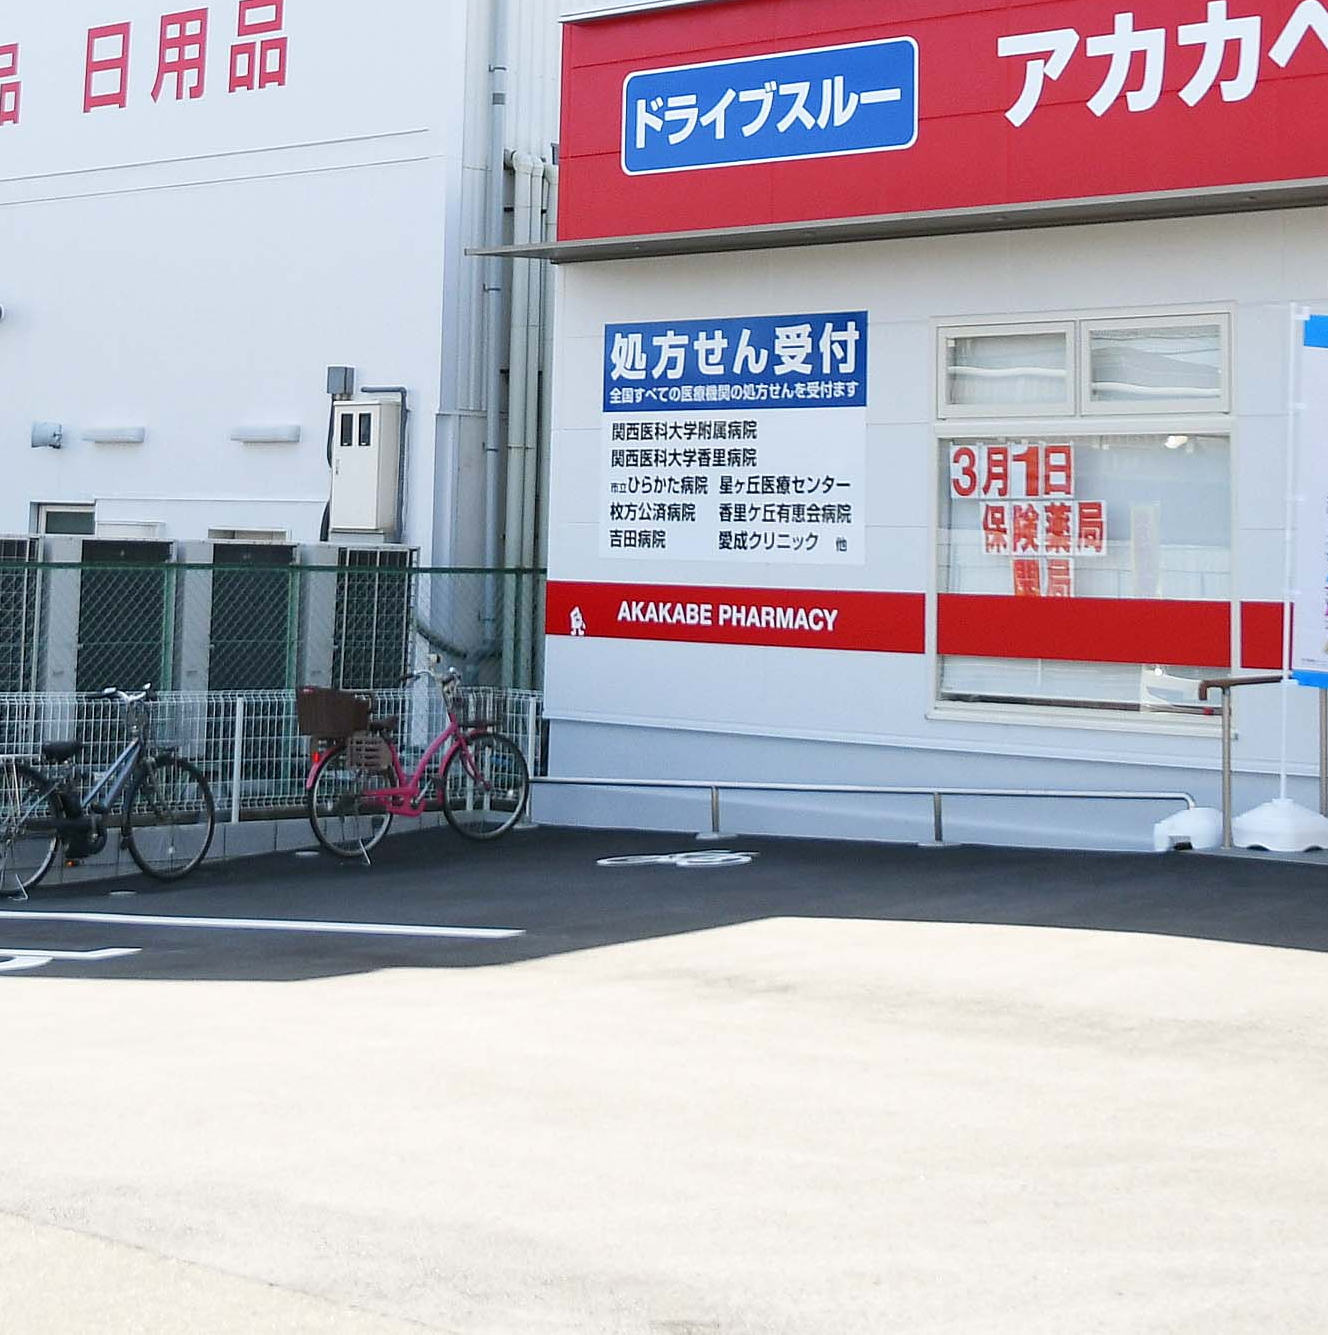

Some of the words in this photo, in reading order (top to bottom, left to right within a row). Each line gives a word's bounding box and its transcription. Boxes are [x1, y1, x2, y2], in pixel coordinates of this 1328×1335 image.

[635, 74, 902, 149] ドライブスルー
[609, 321, 861, 381] 処方せん受付
[609, 381, 860, 405] 全国すべての医療機関の処方せんを受付ます
[611, 420, 758, 441] 関西医科大学附属病院
[611, 447, 758, 468] 関西医科大学香里病院
[952, 445, 1072, 497] 3月1日
[609, 503, 696, 523] 枚方公済病院
[983, 500, 1104, 554] 保険薬局
[609, 529, 667, 550] 吉田病院
[718, 530, 820, 552] 愛成クリニック
[617, 600, 712, 626] AKAKABE
[719, 604, 839, 632] PHARMACY
